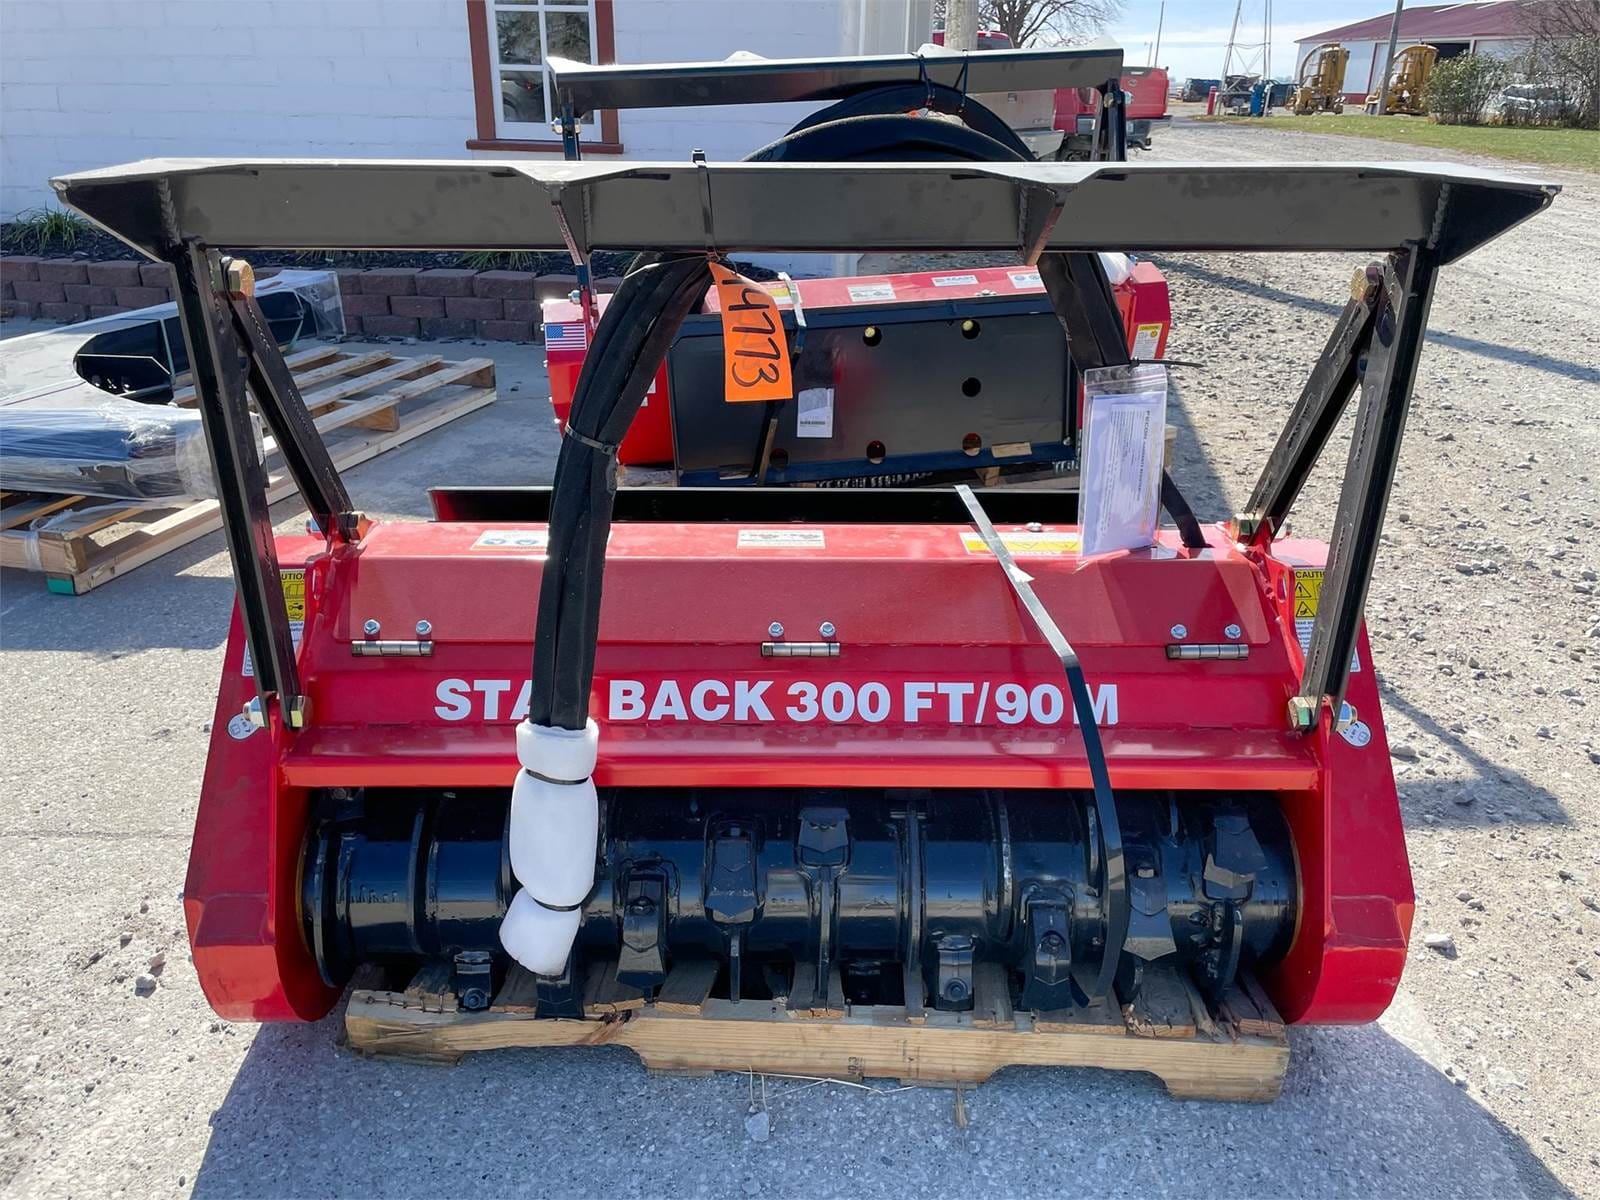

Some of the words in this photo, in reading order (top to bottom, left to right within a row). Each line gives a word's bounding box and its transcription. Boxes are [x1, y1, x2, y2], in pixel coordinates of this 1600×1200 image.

[1295, 571, 1324, 579] CAUTI
[434, 679, 533, 720] STA
[609, 679, 775, 721] BACK
[786, 681, 891, 723] 300
[903, 682, 1064, 724] FT/90
